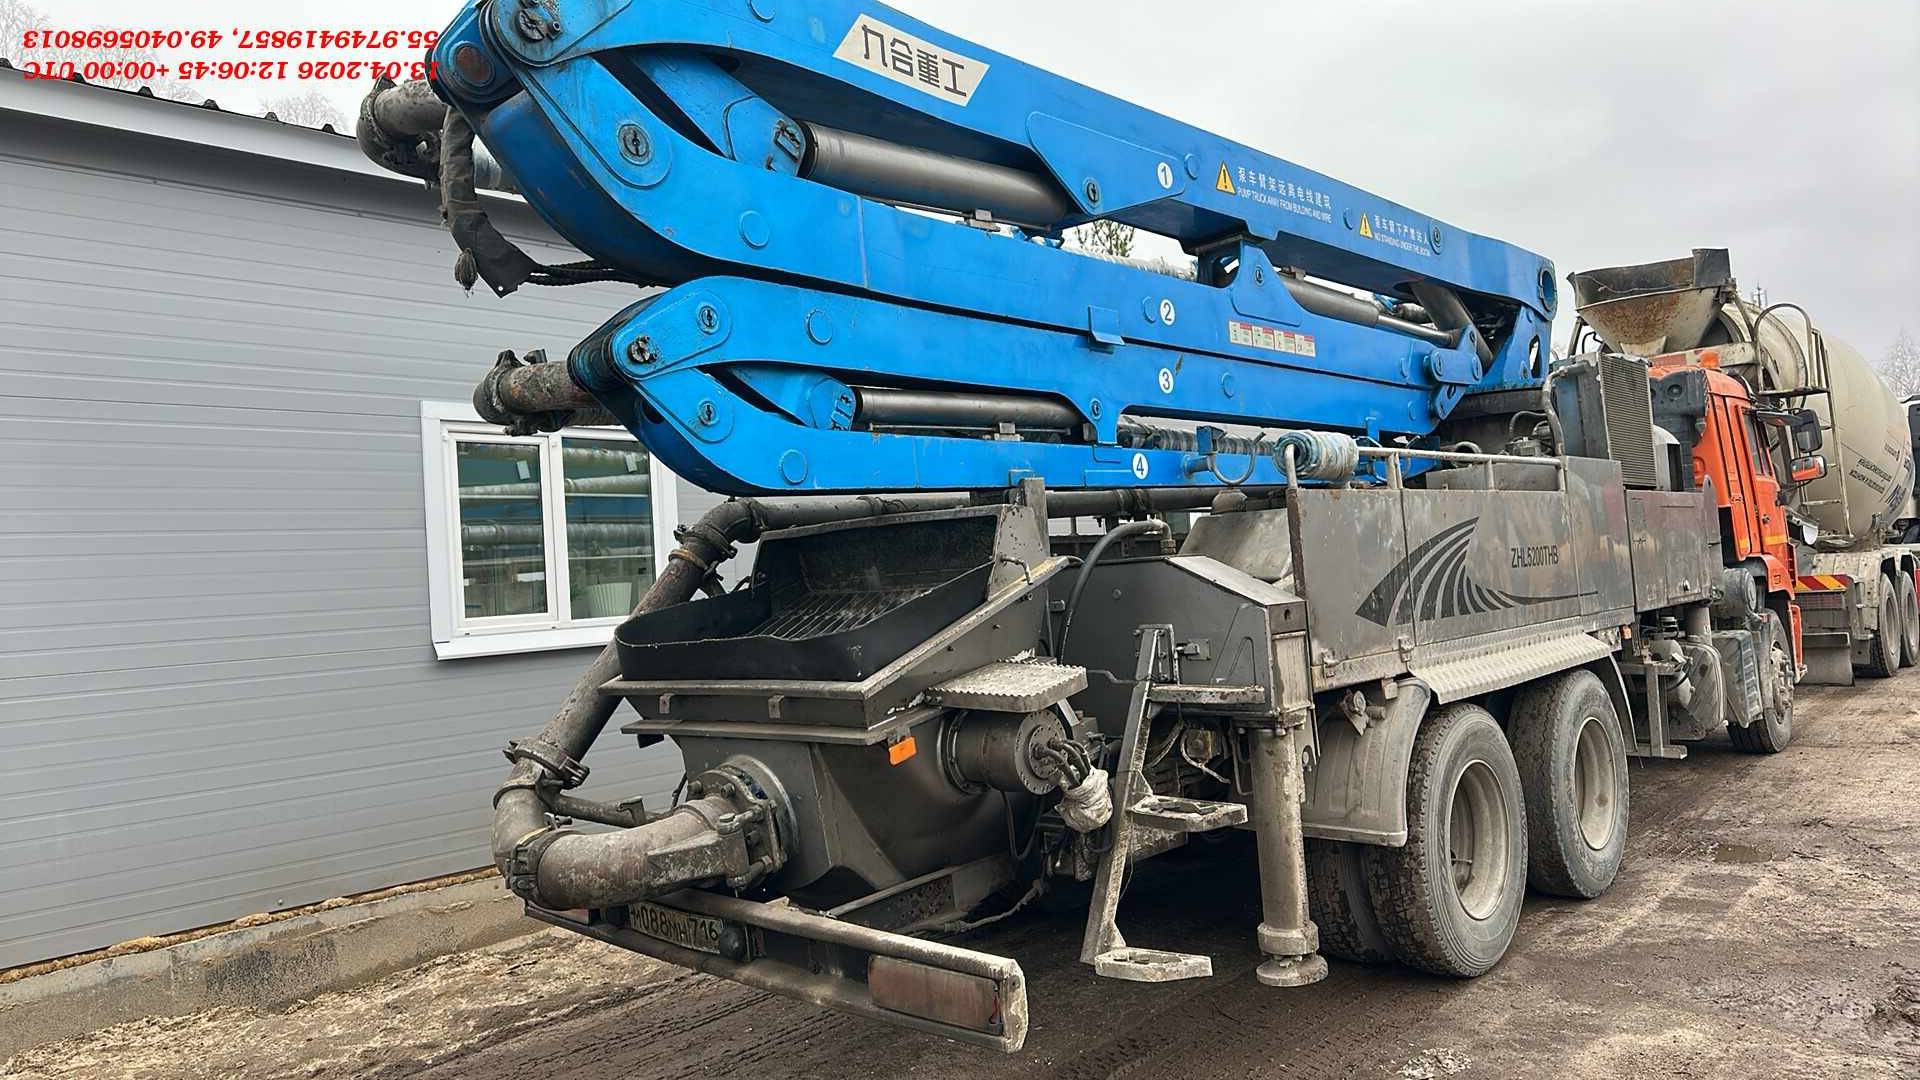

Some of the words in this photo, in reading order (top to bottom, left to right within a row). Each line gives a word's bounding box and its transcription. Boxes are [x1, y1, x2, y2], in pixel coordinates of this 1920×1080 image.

[1162, 302, 1172, 322] 2
[1161, 371, 1171, 390] 3
[1136, 457, 1145, 476] 4
[1511, 544, 1559, 569] ZHL5200THB
